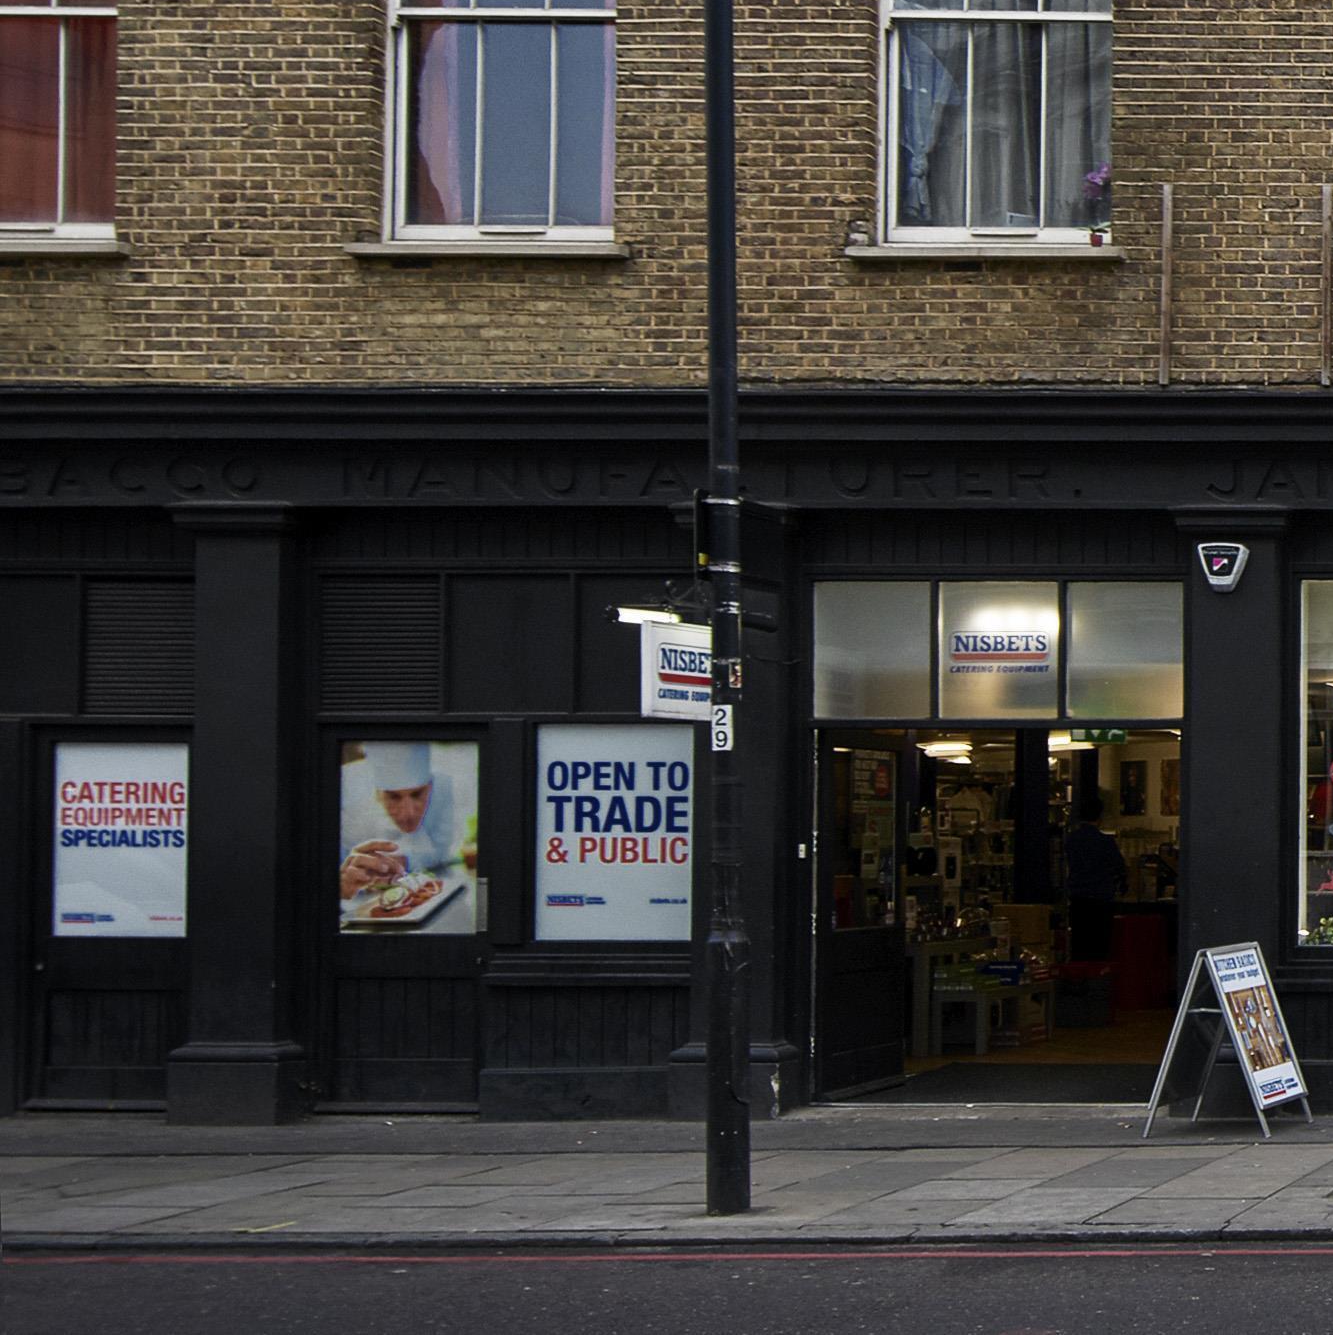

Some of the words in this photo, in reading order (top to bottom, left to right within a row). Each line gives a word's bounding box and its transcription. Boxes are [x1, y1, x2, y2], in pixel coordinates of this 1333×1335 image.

[342, 456, 1081, 500] MANUFATURER.
[953, 634, 1047, 653] NISBETS
[660, 647, 712, 675] NISBE
[950, 665, 993, 674] CATERING
[996, 665, 1050, 674] EQUIPMENT
[547, 760, 636, 791] OPEN
[646, 760, 690, 791] TO
[60, 780, 186, 804] CATERING
[60, 807, 186, 827] EQUIPMENT
[546, 796, 689, 833] TRADE
[60, 829, 186, 848] SPECIALISTS
[546, 836, 569, 864] &
[578, 836, 689, 864] PUBLIC
